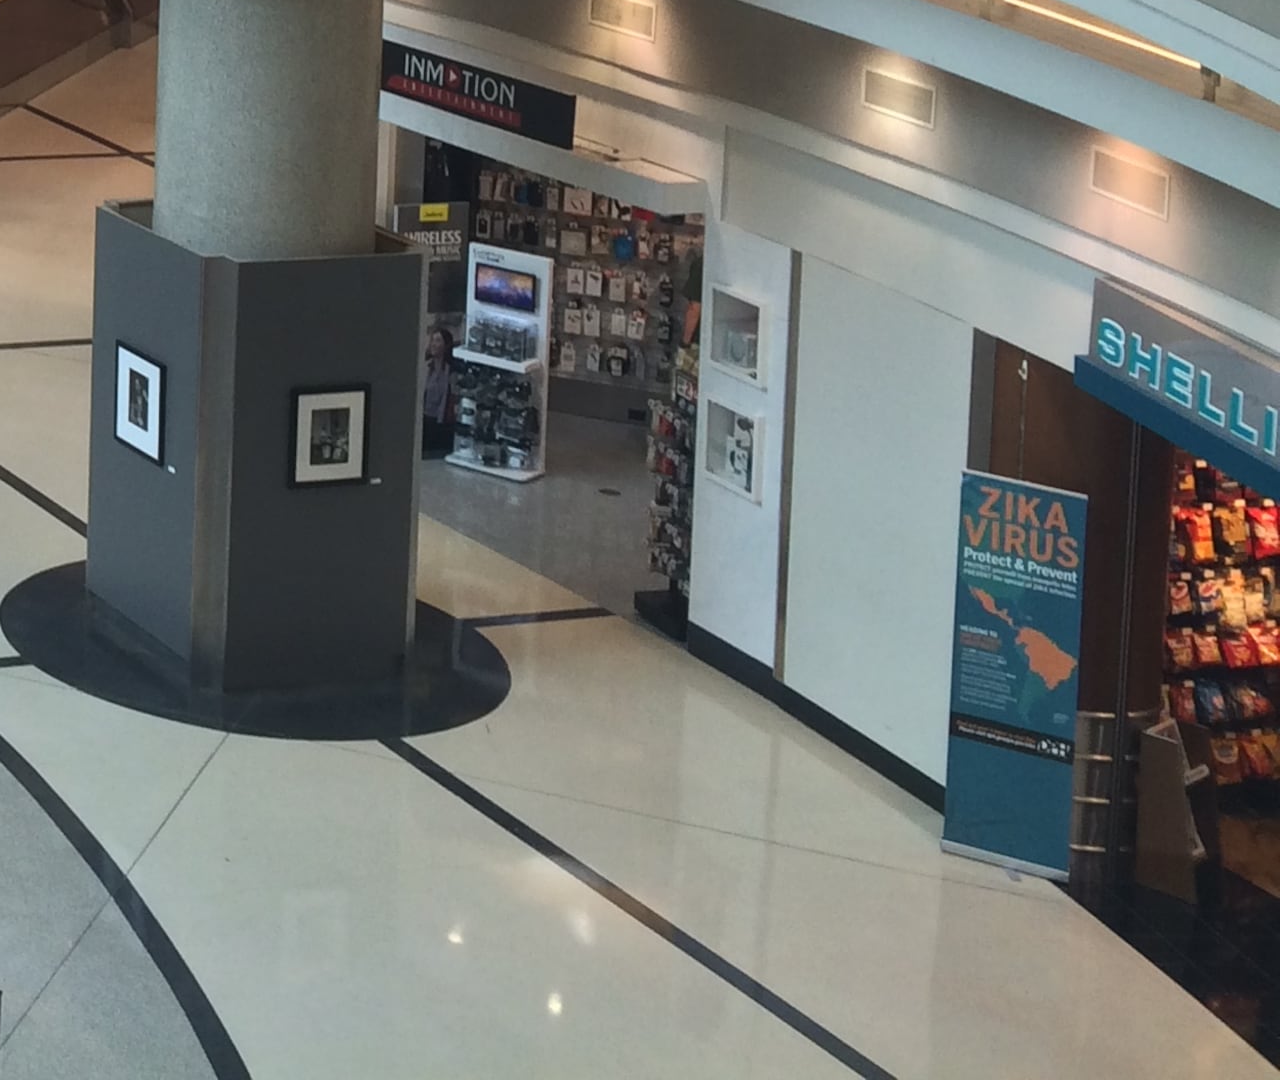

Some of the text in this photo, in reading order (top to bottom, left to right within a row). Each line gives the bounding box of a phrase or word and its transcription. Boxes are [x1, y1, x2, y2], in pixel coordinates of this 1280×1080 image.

[1097, 317, 1278, 457] SHELLI
[978, 485, 1069, 534] ZIKA
[963, 514, 1080, 569] VIRUS
[963, 546, 1078, 584] Protect & Prevent
